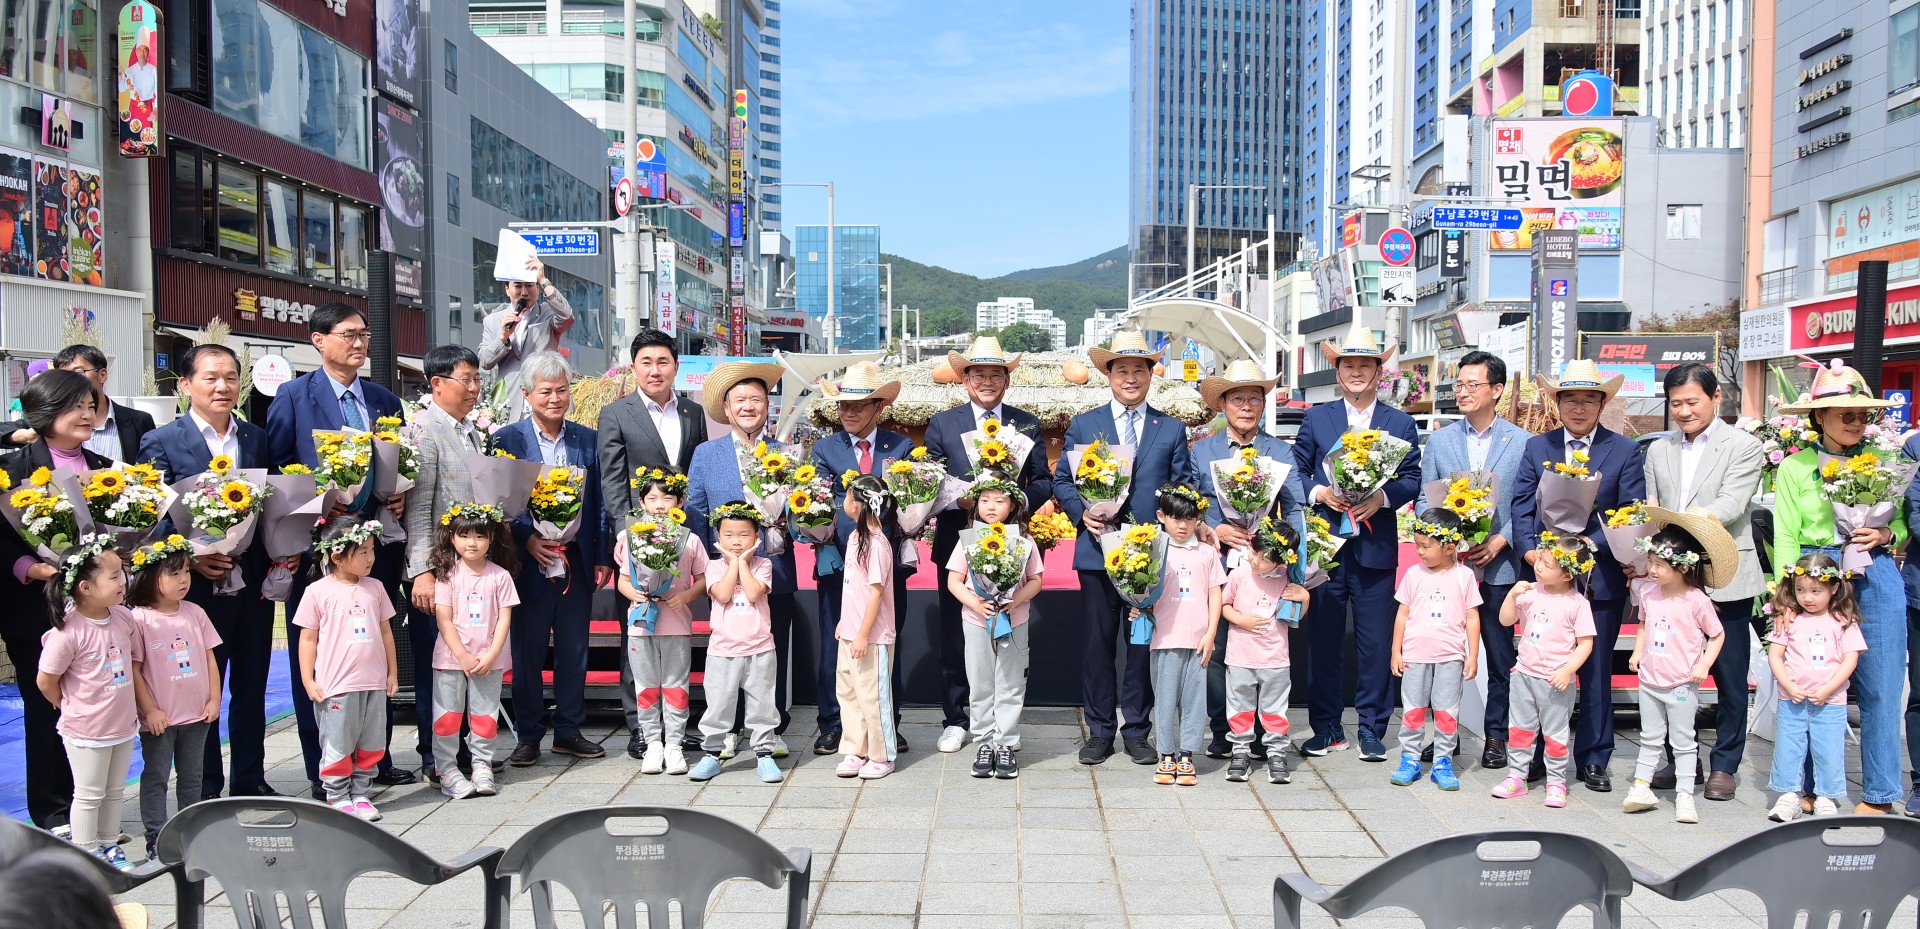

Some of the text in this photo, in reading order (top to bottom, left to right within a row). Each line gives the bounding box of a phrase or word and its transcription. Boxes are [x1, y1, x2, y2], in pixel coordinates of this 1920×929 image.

[1499, 140, 1521, 153] 명재
[731, 159, 741, 191] 더타이
[0, 175, 28, 192] HOOKAH
[1496, 160, 1572, 203] 밀면
[1436, 209, 1466, 220] 구남로
[535, 235, 564, 246] 구남로
[564, 246, 595, 254] 30beon-gil
[1383, 270, 1412, 279] 견인지역
[661, 291, 672, 331] 낙곱새
[1888, 299, 1920, 326] KIN
[1744, 312, 1779, 331] 심재원한의원
[1551, 301, 1566, 377] SAVE ZONE
[1743, 333, 1777, 349] 성장연구소
[1599, 344, 1648, 360] 대국민
[1661, 351, 1706, 361] 최대 90%
[159, 358, 166, 366] 28
[170, 671, 198, 682] I'm Robot
[246, 836, 293, 847] 부경종합렌탈
[616, 844, 666, 856] 부경종합렌탈
[1826, 854, 1874, 866] 부경종합렌탈
[1480, 870, 1531, 882] 부경종합렌탈
